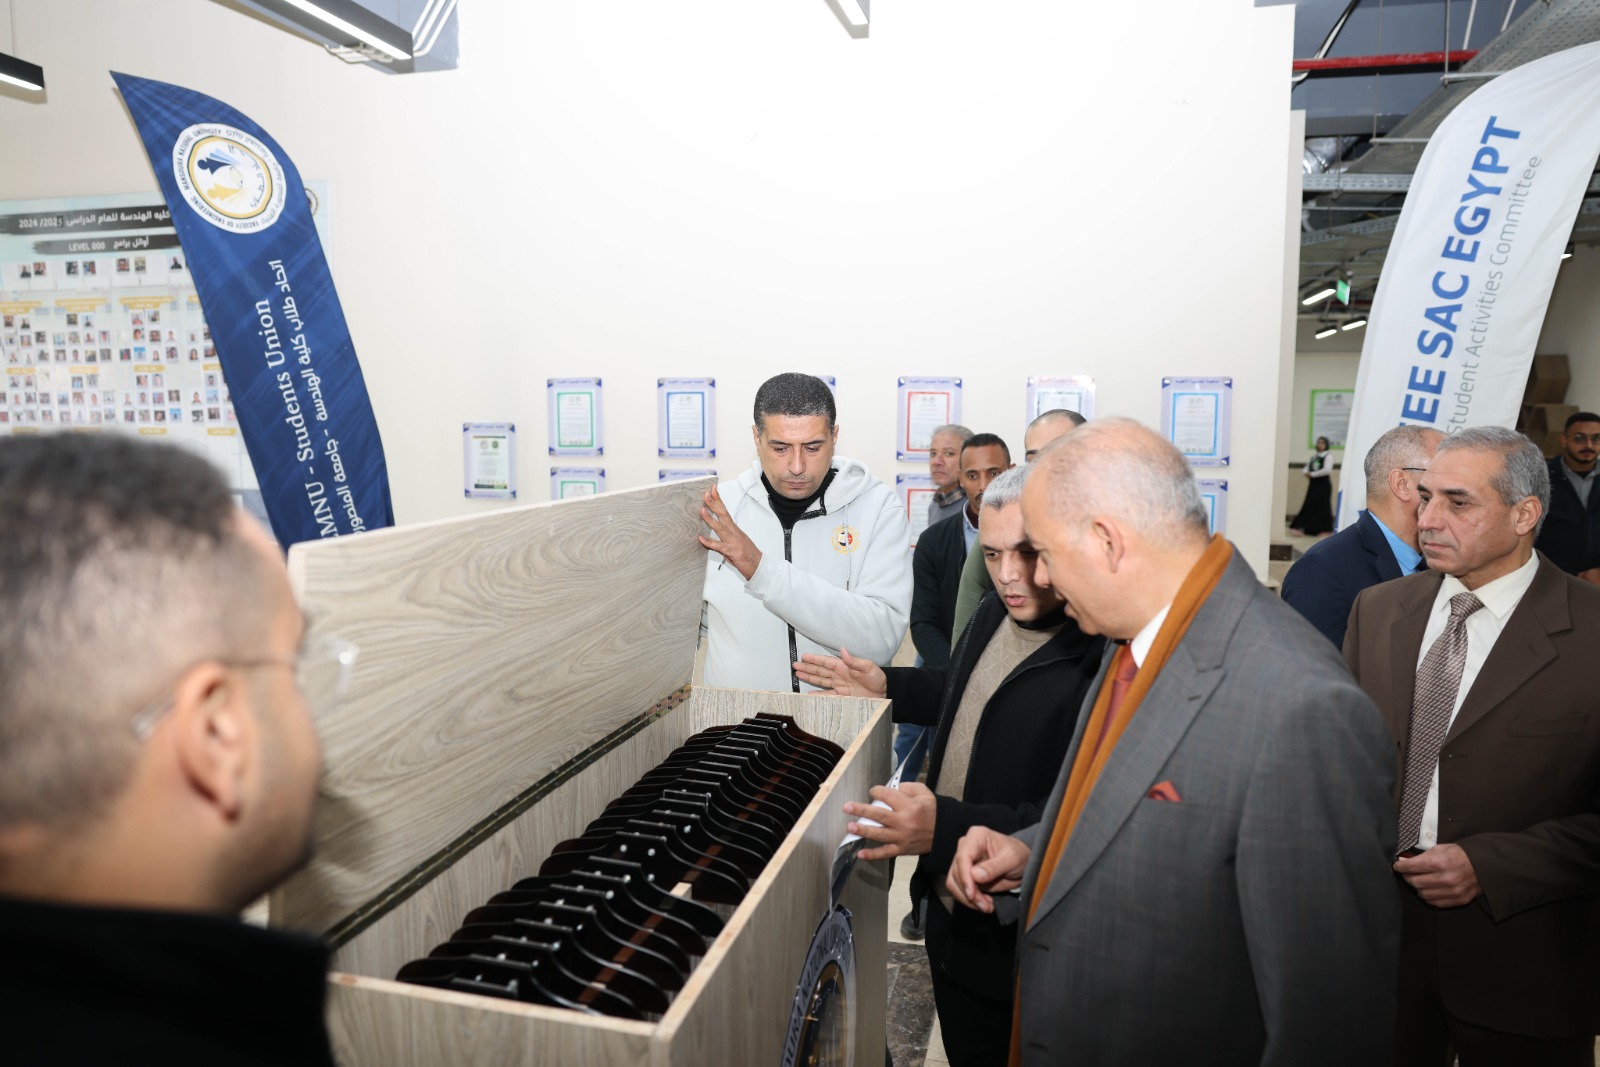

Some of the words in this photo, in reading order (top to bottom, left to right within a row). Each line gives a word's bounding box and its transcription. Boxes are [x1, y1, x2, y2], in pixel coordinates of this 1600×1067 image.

[1441, 115, 1522, 264] EGYPT
[18, 218, 38, 229] 2024
[68, 242, 90, 252] LEVEL
[268, 259, 291, 293] اتحاد
[1464, 268, 1504, 358] Activities
[1489, 156, 1543, 266] Committee
[255, 298, 286, 368] Union
[281, 296, 305, 332] طلاب
[1415, 270, 1471, 360] SAC
[290, 334, 311, 365] كلية
[276, 371, 314, 462] Students
[300, 368, 329, 422] الهندسة
[324, 438, 347, 482] جامعة
[304, 481, 340, 538] MNU
